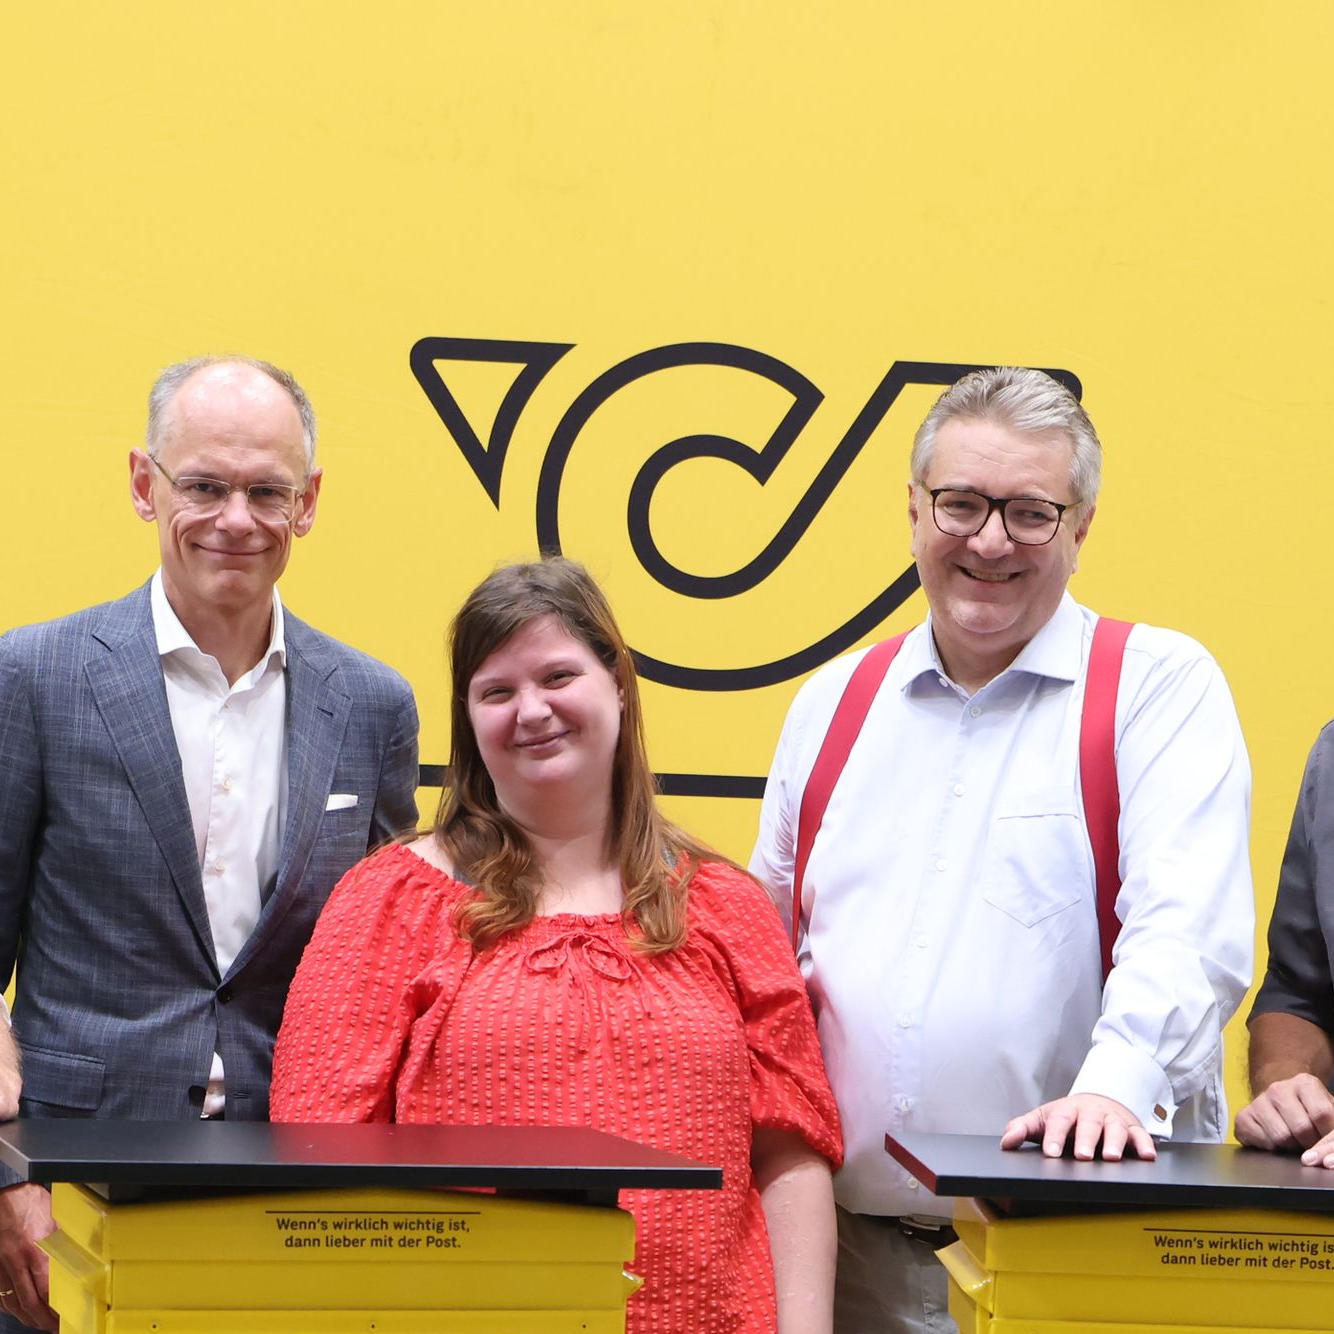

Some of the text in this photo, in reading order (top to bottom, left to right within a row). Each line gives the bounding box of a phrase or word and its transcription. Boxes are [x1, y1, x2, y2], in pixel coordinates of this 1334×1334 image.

[333, 1218, 388, 1230] wirklich
[393, 1218, 444, 1233] wichtig
[449, 1220, 470, 1232] ist,
[285, 1236, 461, 1248] dann lieber mit der Post.
[1209, 1238, 1263, 1250] wirklich
[1268, 1240, 1319, 1255] wichtig
[1161, 1253, 1334, 1270] dann lieber mit der Post.
